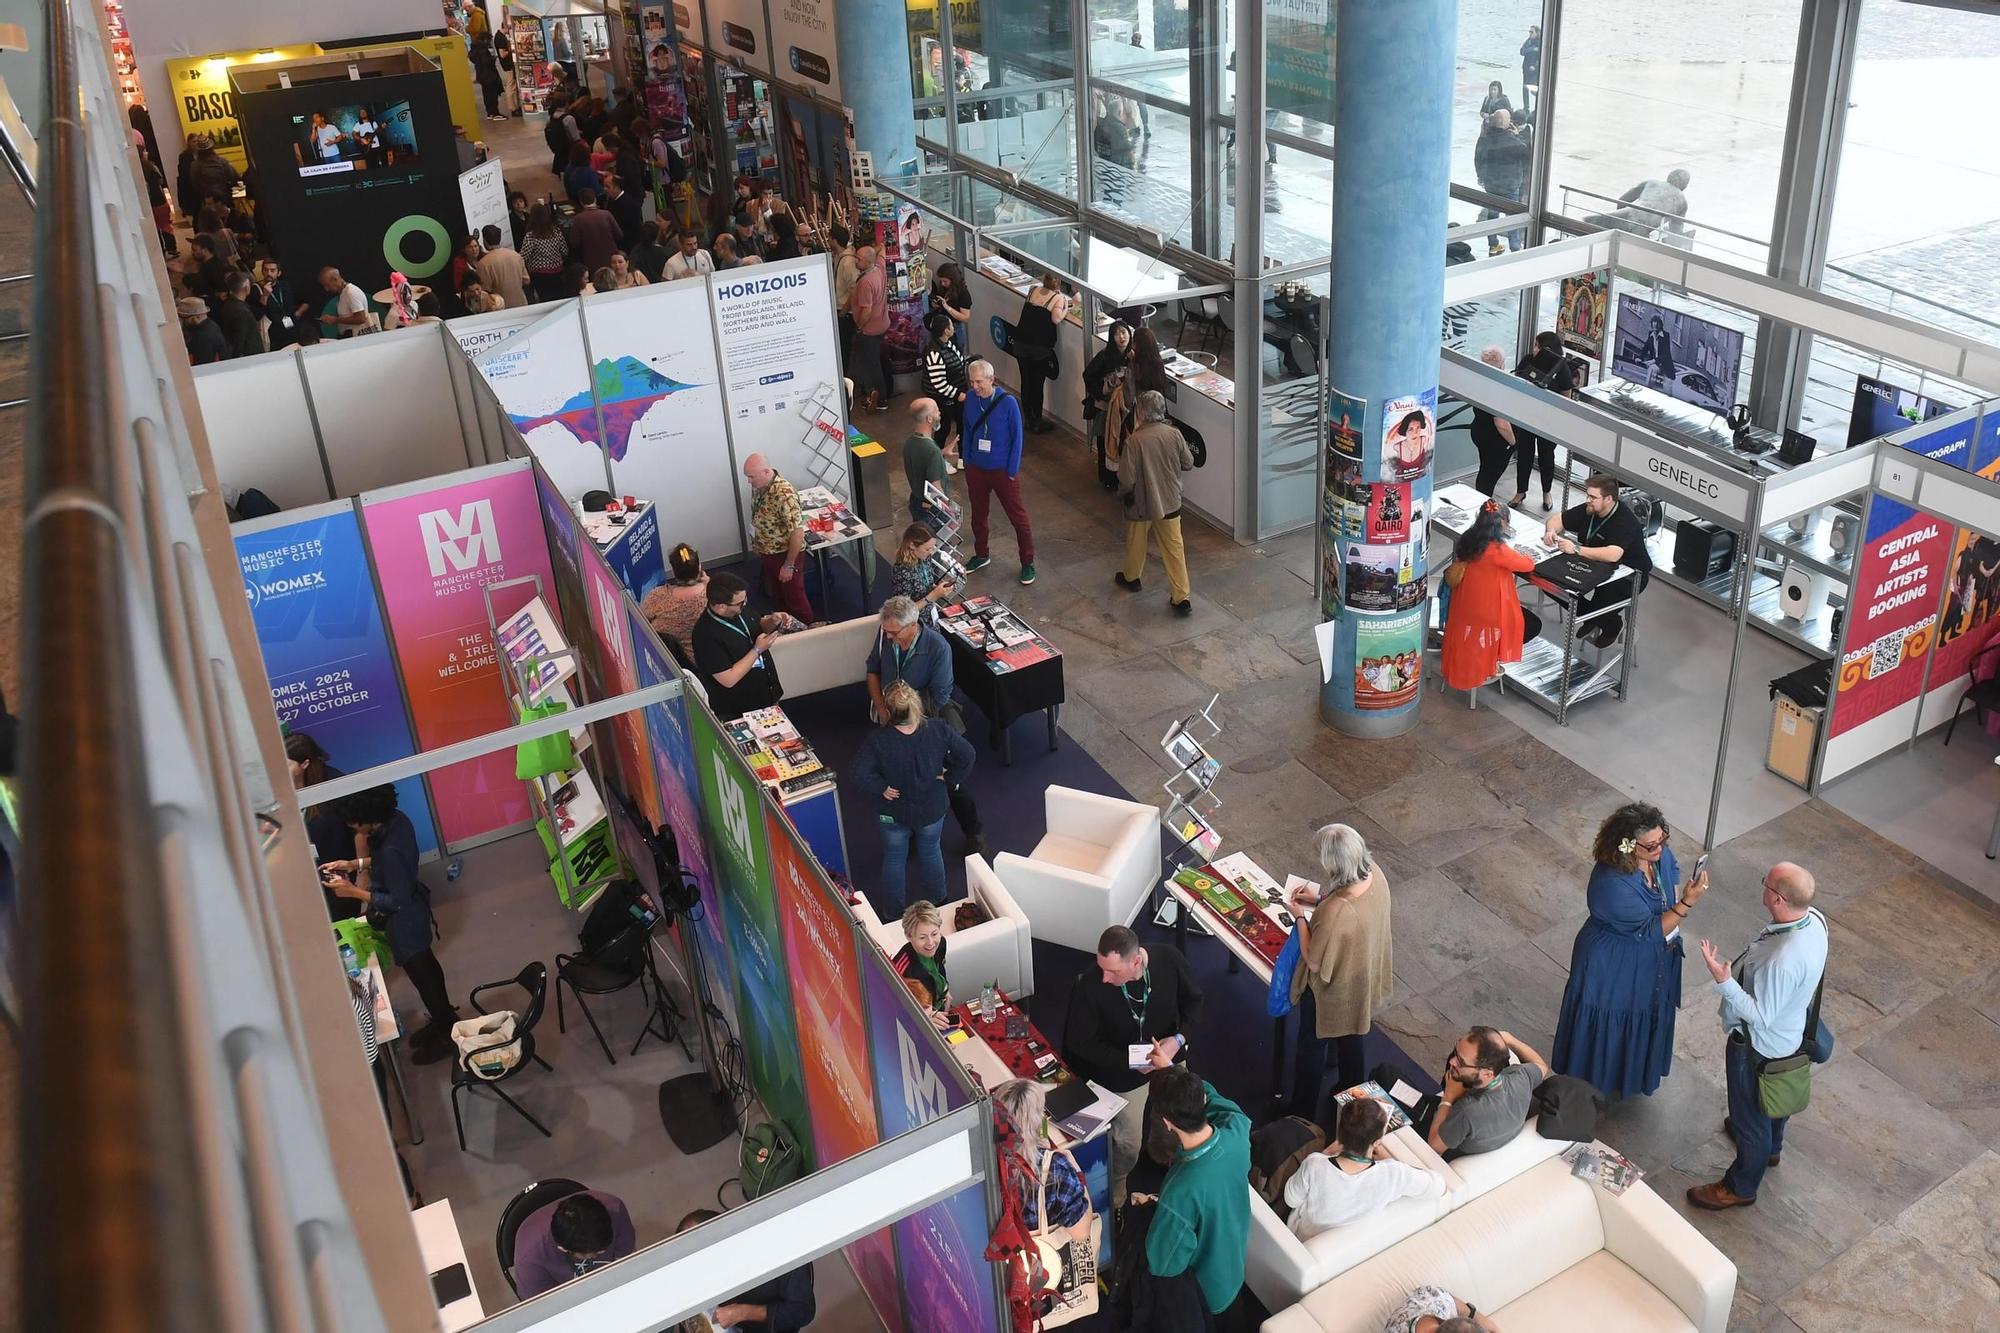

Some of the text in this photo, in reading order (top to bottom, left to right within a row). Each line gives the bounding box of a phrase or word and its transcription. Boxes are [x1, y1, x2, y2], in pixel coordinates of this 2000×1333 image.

[184, 91, 239, 122] BASQ
[718, 273, 807, 300] HORIZONS
[727, 302, 750, 312] WORLD
[761, 297, 782, 306] MUSIC
[743, 306, 776, 316] ENGLAND,
[777, 300, 805, 310] IRELAND,
[723, 316, 759, 327] NORTHERN
[724, 324, 759, 335] SCOTLAND
[776, 317, 797, 325] WALES
[1861, 383, 1892, 401] GENELEC
[1925, 438, 1967, 459] TOGRAPH
[1648, 457, 1719, 500] GENELEC
[628, 520, 649, 546] IRELAND
[630, 524, 656, 556] NORTHERN
[1878, 524, 1938, 559] CENTRAL
[241, 540, 322, 565] MANCHESTER
[243, 548, 324, 573] MUSIC CITY
[631, 540, 652, 567] IRELAND
[1888, 549, 1921, 574] ASIA
[260, 571, 325, 596] WOMEX
[433, 565, 505, 588] MANCHESTER
[435, 573, 505, 597] MUSIC CITY
[1873, 565, 1929, 599] ARTISTS
[1868, 583, 1927, 620] BOOKING
[1358, 612, 1421, 630] SAHARIENNES
[458, 633, 483, 647] THE
[448, 643, 498, 663] & IREL
[271, 669, 350, 698] OMEX 2024
[275, 682, 354, 711] ANCHESTER
[308, 691, 369, 714] OCTOBER
[929, 1218, 953, 1263] 215
